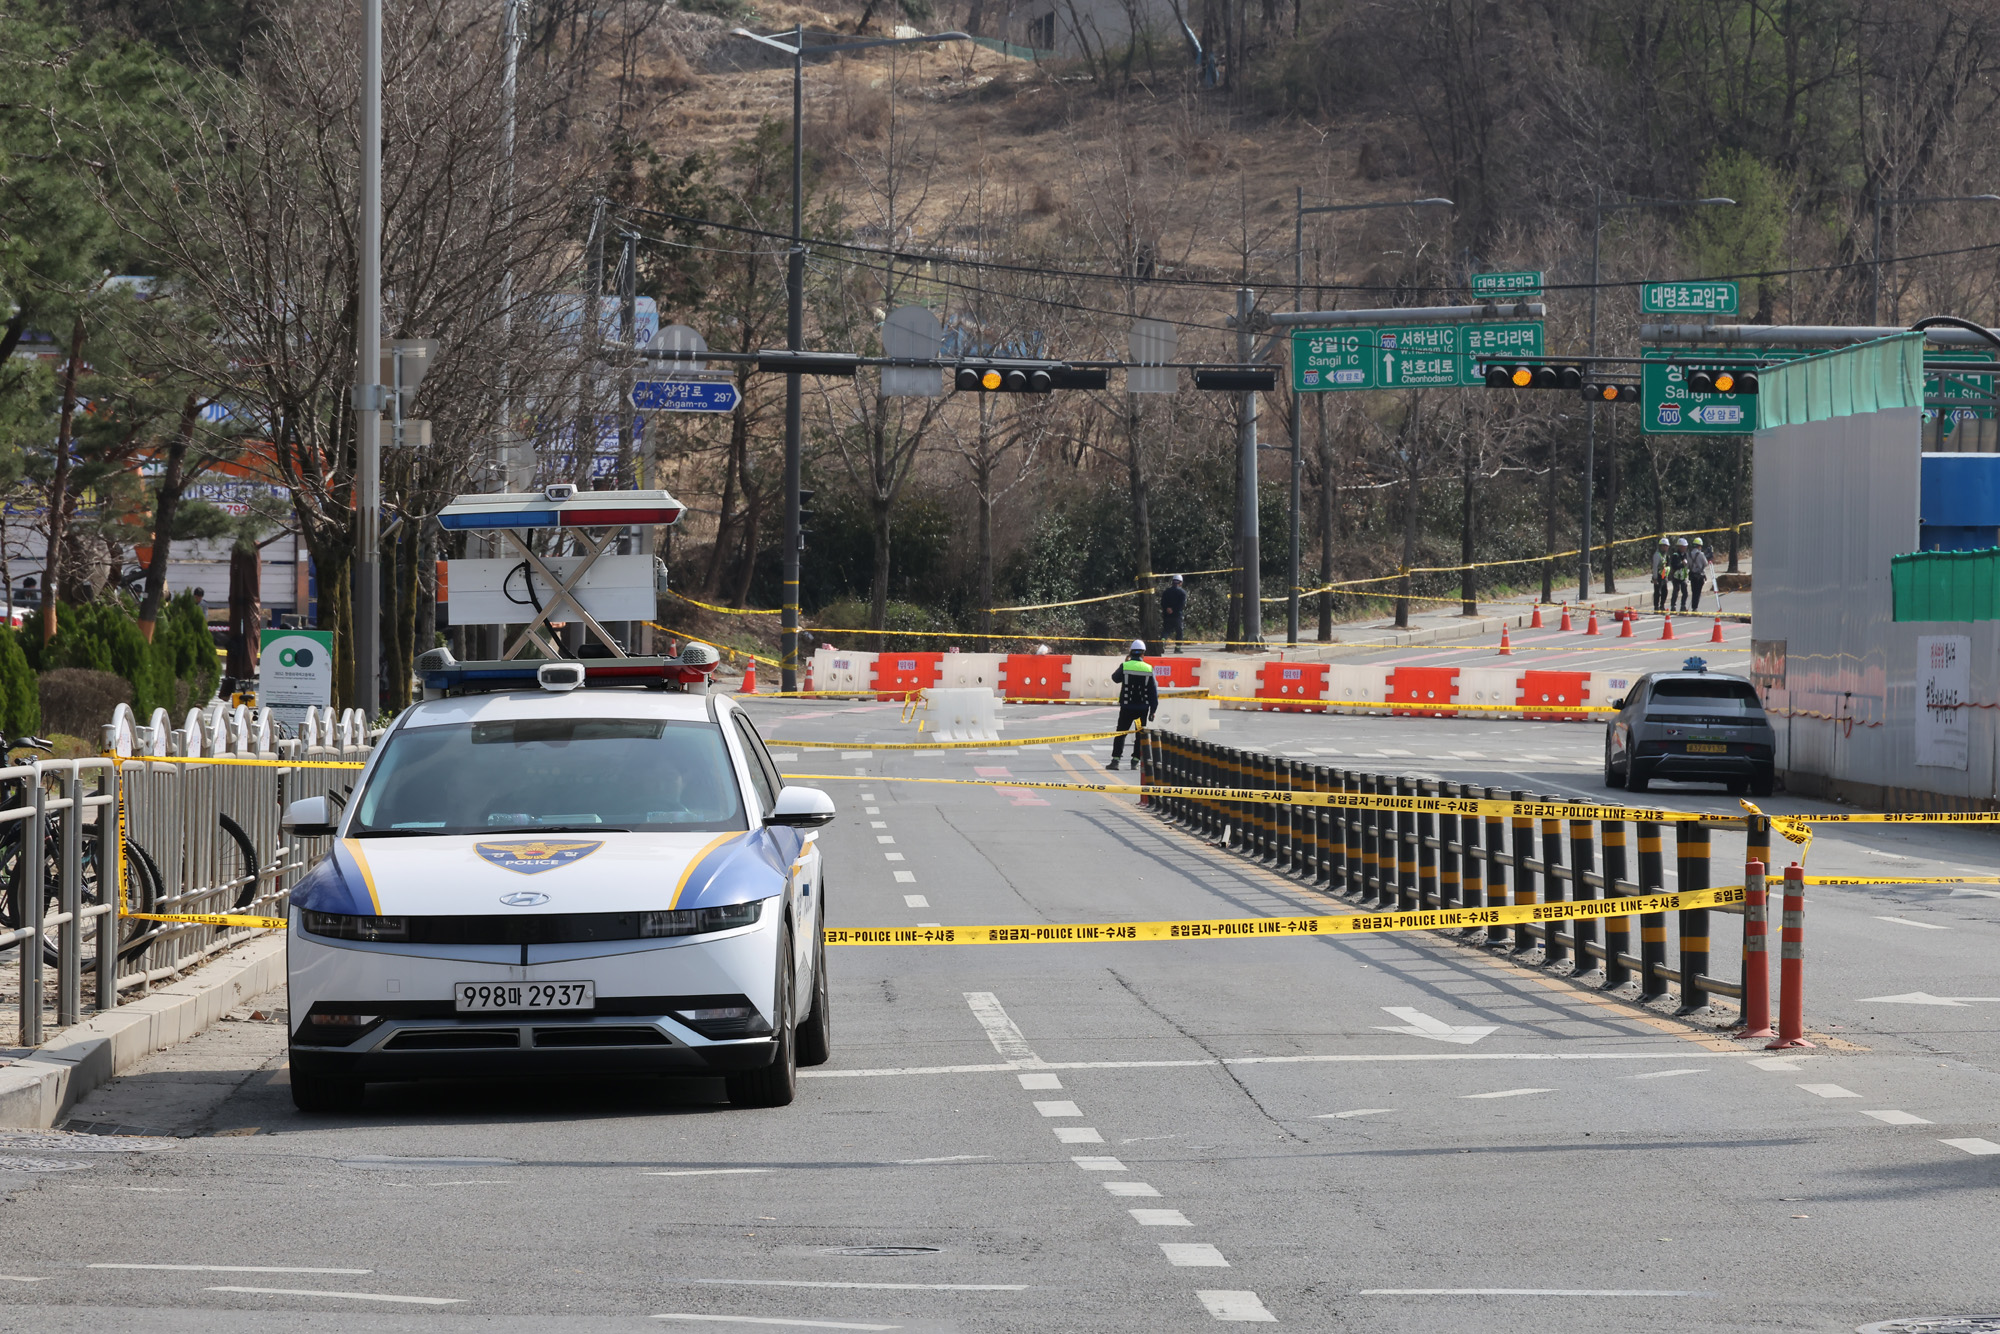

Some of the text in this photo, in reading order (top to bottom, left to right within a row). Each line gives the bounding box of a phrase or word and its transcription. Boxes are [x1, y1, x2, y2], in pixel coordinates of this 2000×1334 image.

[1652, 286, 1729, 308] 대명초교입구
[1382, 340, 1396, 349] 100
[1468, 330, 1534, 347] 굽은다리역
[1308, 354, 1358, 369] Sangil IC
[1401, 359, 1454, 375] 천호대로
[1305, 375, 1318, 384] 100
[1401, 374, 1453, 384] Cheonhodaero
[664, 386, 703, 398] 상암로
[714, 392, 732, 402] 297
[658, 399, 708, 408] Sangam-ro
[1662, 411, 1678, 422] 100
[1706, 410, 1737, 420] 상암로
[1231, 789, 1292, 801] LINE-수사중
[1327, 795, 1478, 812] 출입금지-POLICE LINE-수사중
[1513, 804, 1664, 820] 출입금지-POLICE LINE-수사중
[1532, 896, 1680, 920] 출입금지-POLICE LINE-수사중
[1352, 910, 1500, 930] 출입금지-POLICE LINE-수사중
[895, 930, 955, 942] LINE-수사중
[988, 926, 1136, 941] 출입금지-POLICE LINE-수사중
[1170, 920, 1318, 937] 출입금지-POLICE LINE-수사중
[464, 984, 586, 1008] 998마 2937
